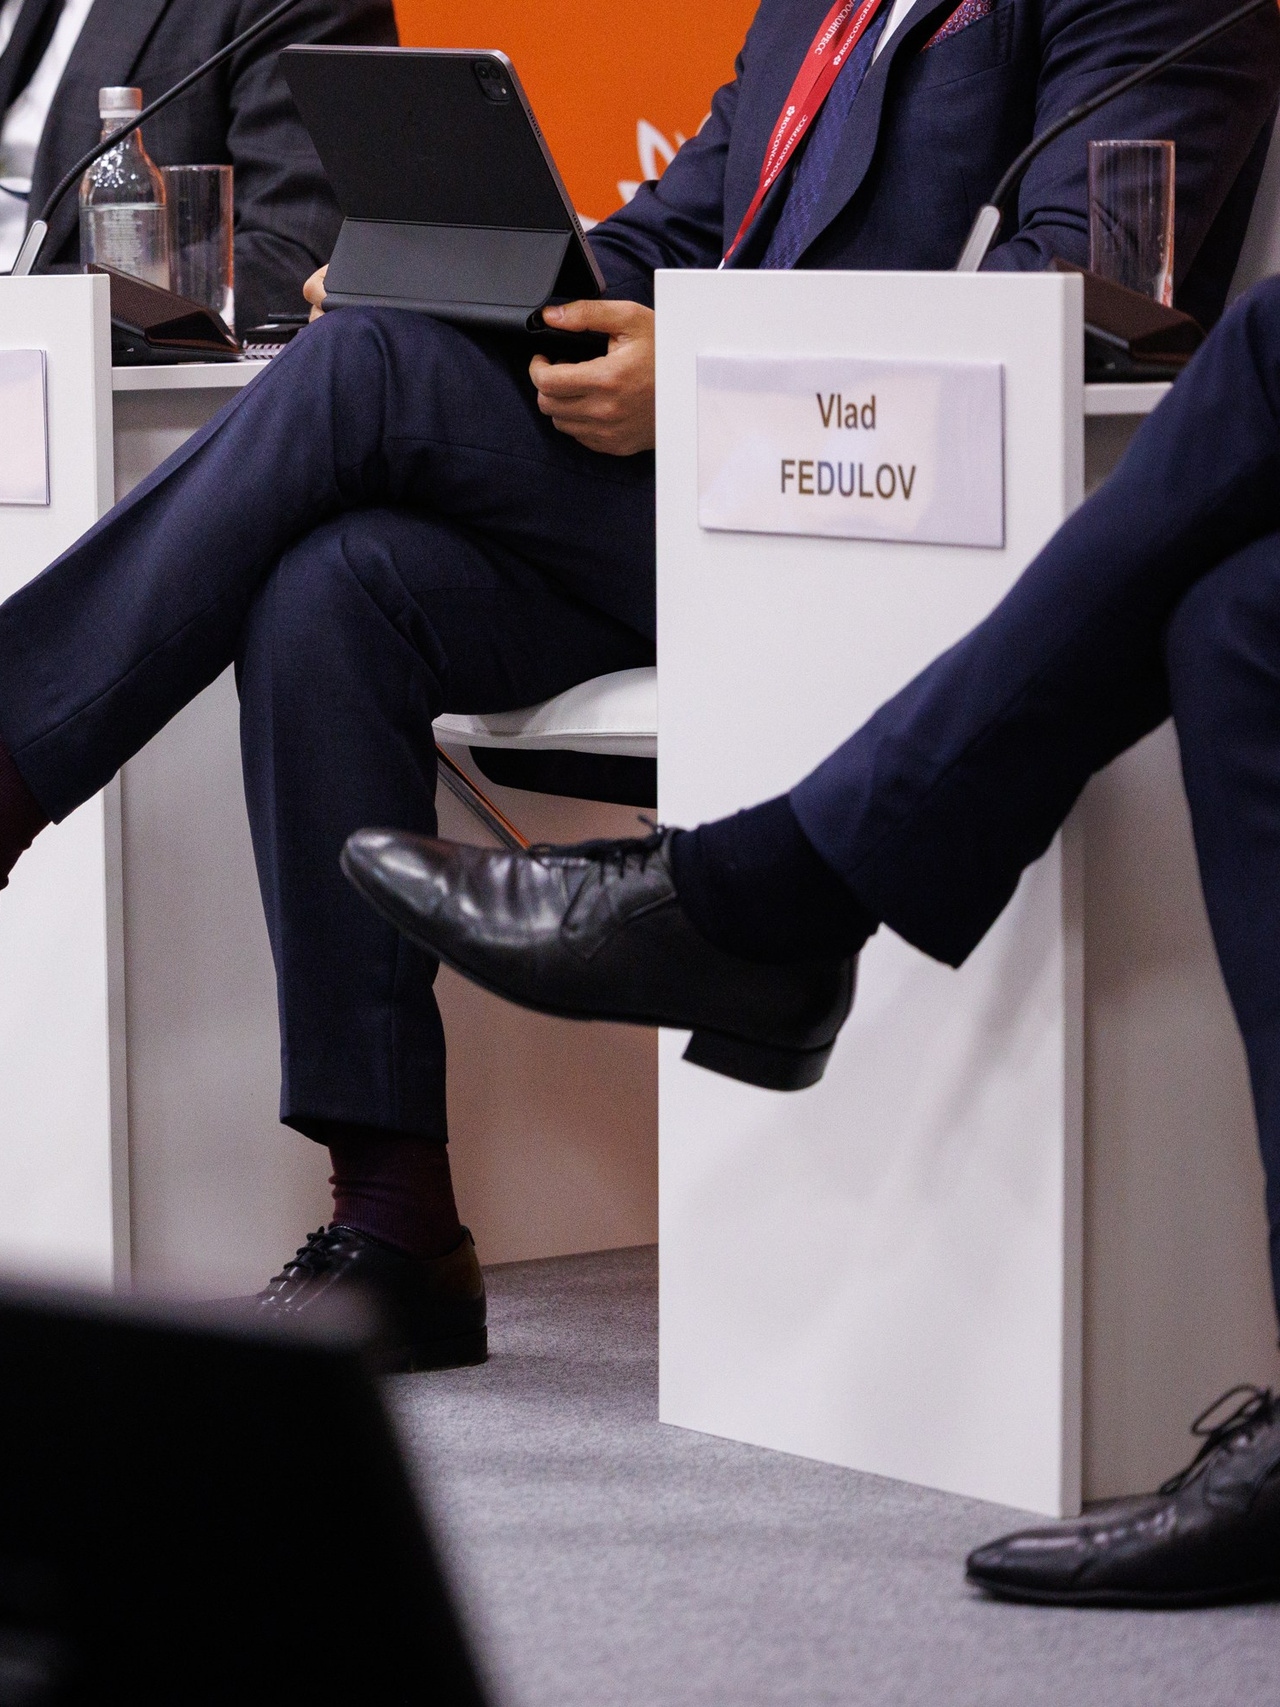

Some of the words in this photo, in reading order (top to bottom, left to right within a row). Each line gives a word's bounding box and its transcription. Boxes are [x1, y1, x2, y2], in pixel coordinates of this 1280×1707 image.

[764, 116, 790, 175] ROSCONGR
[770, 114, 808, 177] РОСКОНГРЕСС
[816, 393, 876, 430] Vlad
[781, 459, 916, 500] FEDULOV
